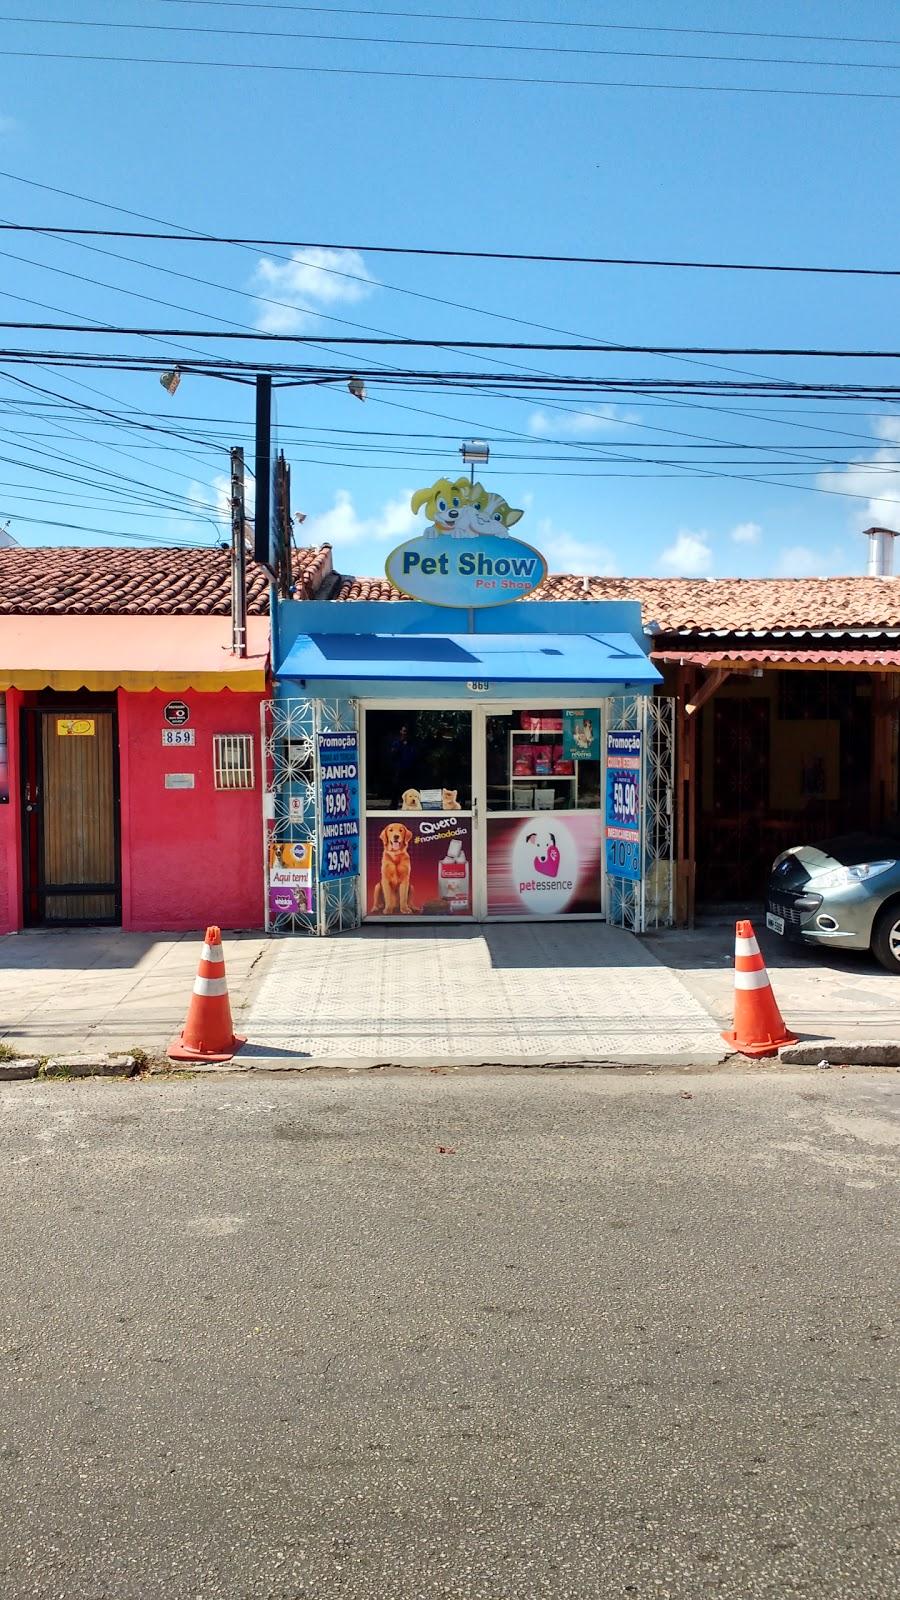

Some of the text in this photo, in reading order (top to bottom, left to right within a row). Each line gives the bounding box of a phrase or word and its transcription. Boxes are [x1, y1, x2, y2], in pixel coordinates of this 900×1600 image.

[403, 551, 536, 576] Pet Show
[475, 579, 533, 590] Pet Shop
[471, 679, 489, 690] 869
[166, 731, 191, 743] 859
[319, 735, 356, 750] Promoção
[608, 734, 640, 752] Promoção
[320, 764, 357, 779] BANHO
[325, 793, 347, 815] 19,90
[419, 817, 457, 834] Quero
[327, 849, 350, 872] 29,90
[611, 841, 638, 870] 10%
[273, 871, 309, 885] Aqui tem!
[519, 880, 573, 893] petessence
